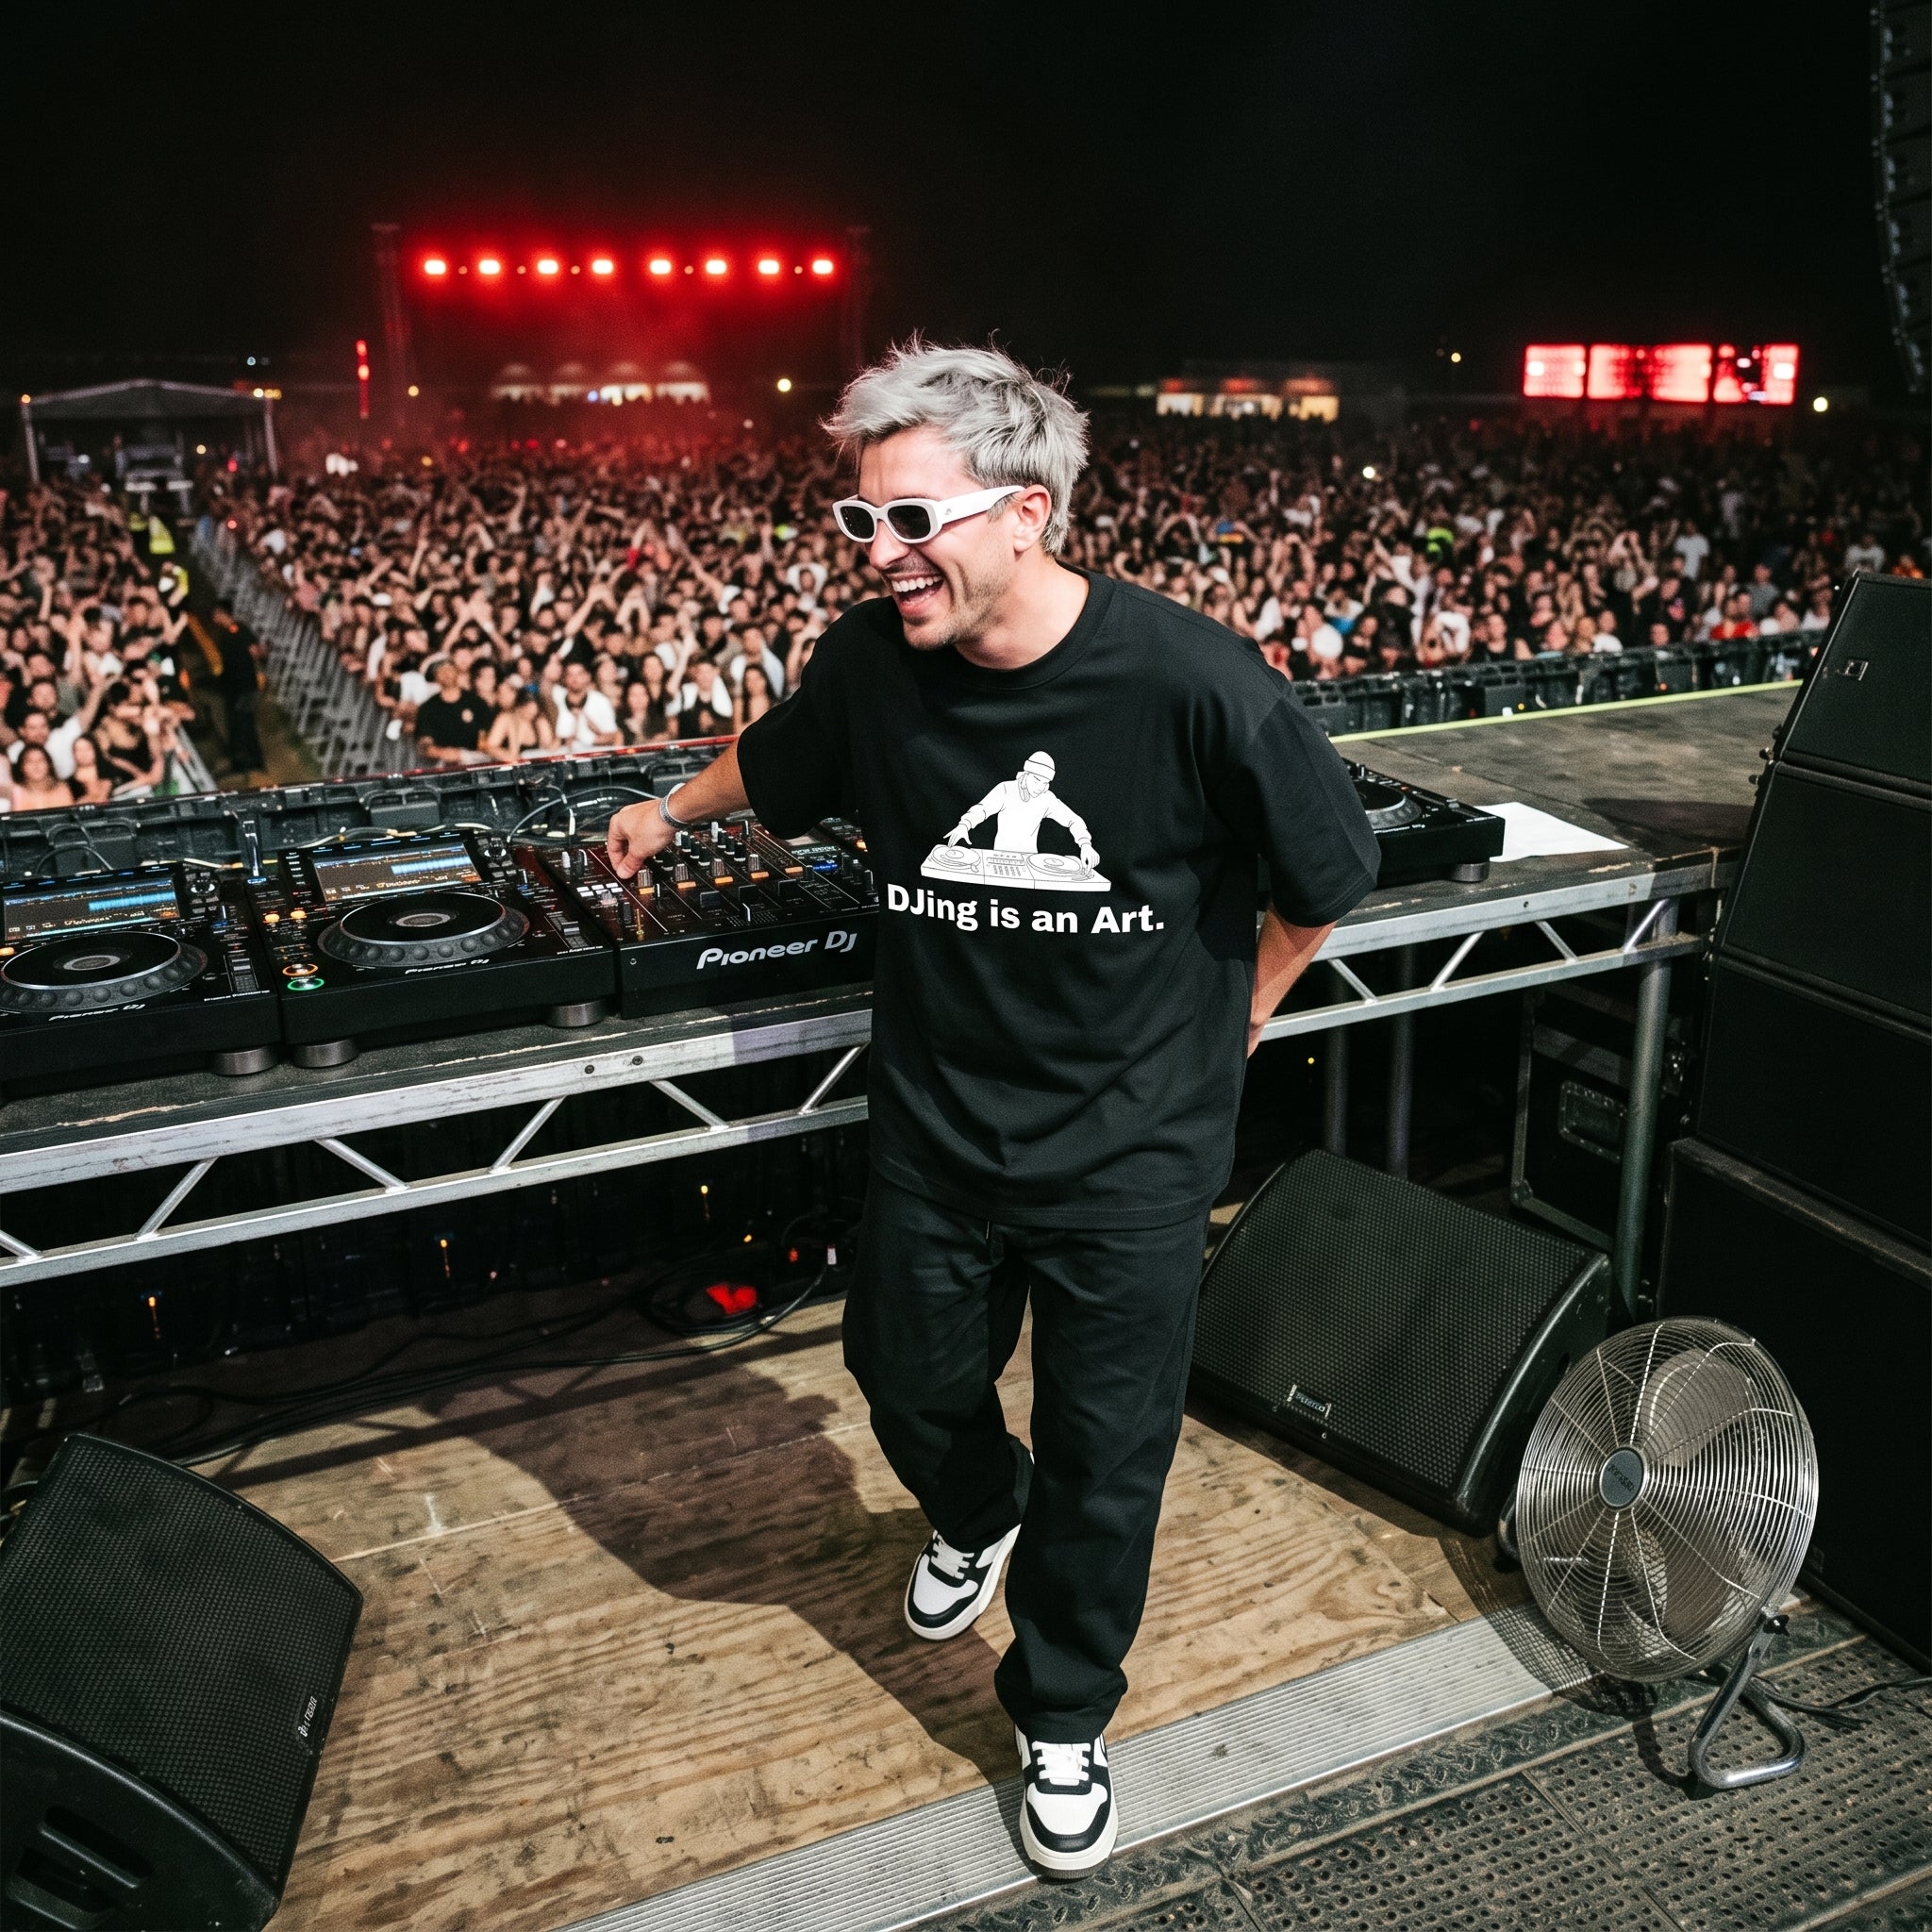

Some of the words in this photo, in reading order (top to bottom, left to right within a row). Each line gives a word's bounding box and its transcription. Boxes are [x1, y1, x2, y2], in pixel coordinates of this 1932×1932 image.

[887, 883, 978, 932] DJing
[990, 898, 1021, 929] is
[1031, 910, 1078, 934] an
[1091, 904, 1165, 934] Art.
[695, 940, 819, 970] Pioneer
[824, 930, 858, 953] DJ
